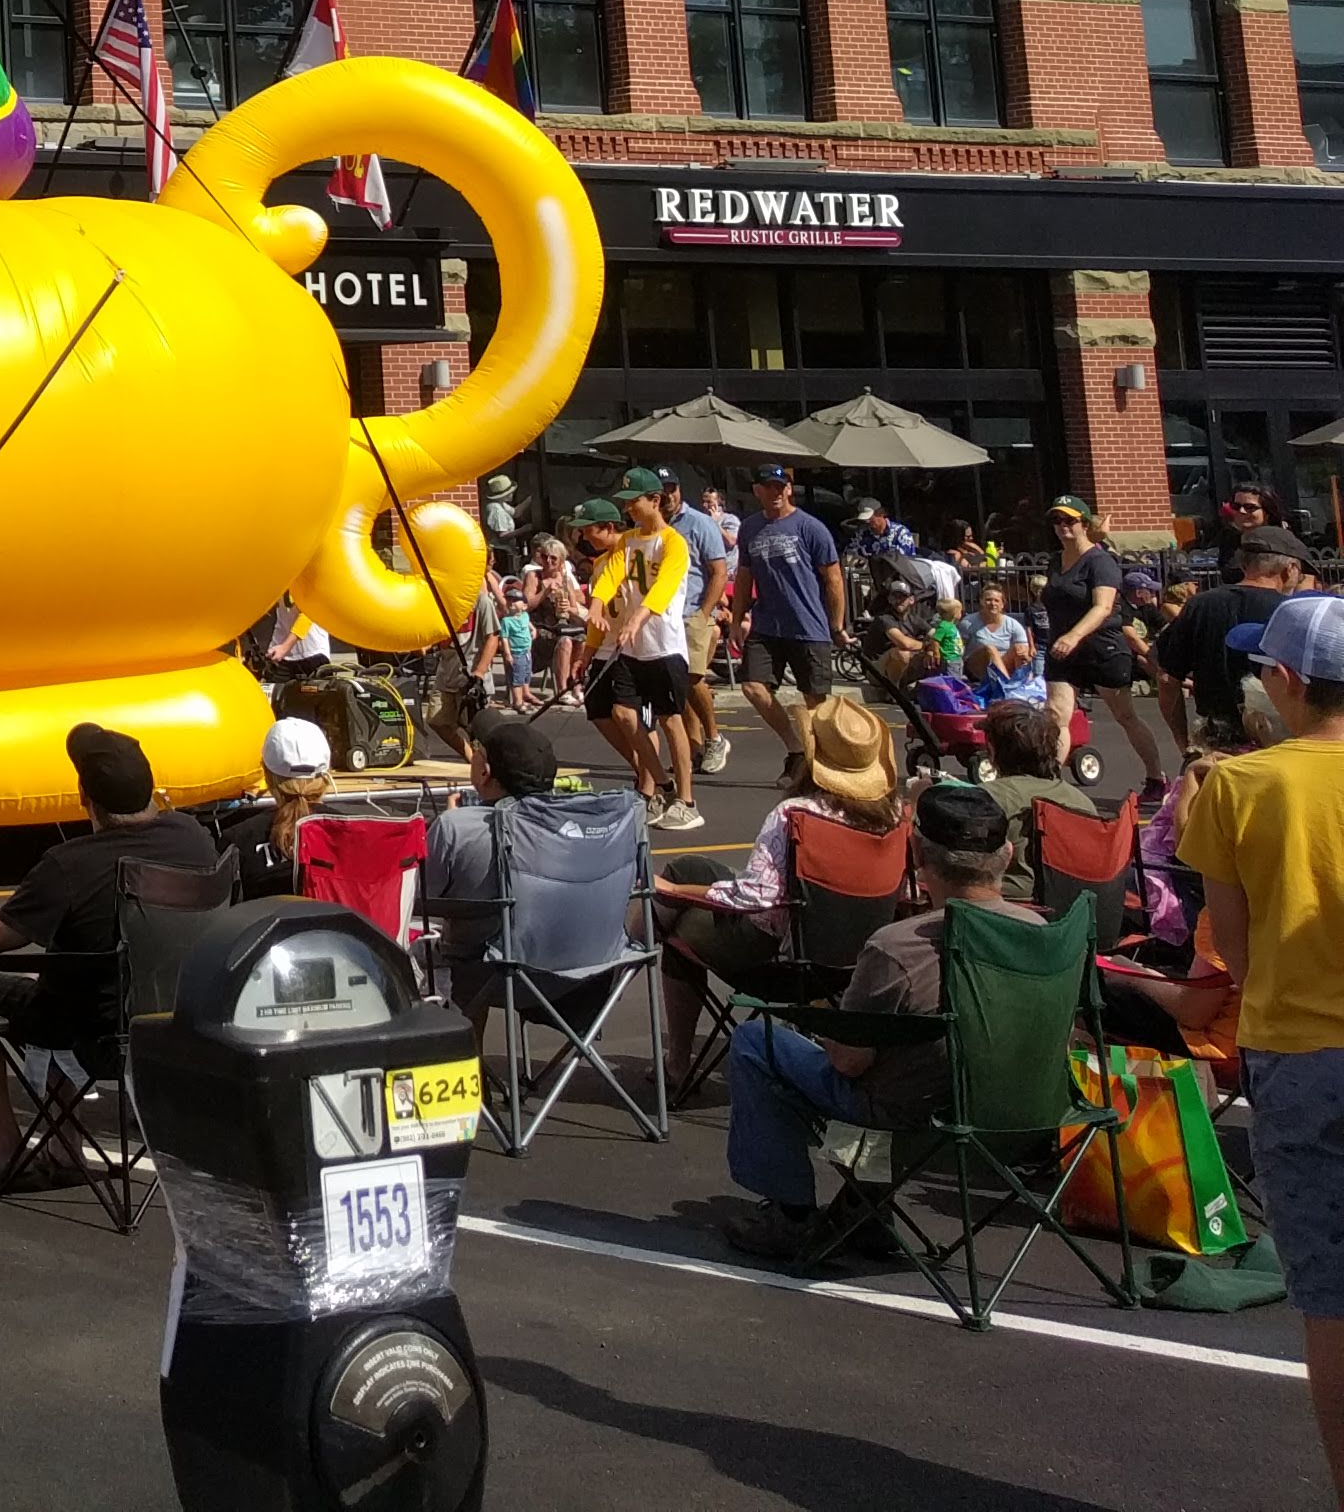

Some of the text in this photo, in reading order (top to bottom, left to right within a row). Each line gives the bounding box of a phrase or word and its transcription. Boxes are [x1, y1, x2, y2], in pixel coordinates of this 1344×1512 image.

[654, 187, 904, 227] REDWATER
[730, 229, 842, 245] RUSTIC GRILLE
[305, 272, 428, 306] HOTEL
[418, 1074, 480, 1105] 6243
[339, 1182, 411, 1254] 1553
